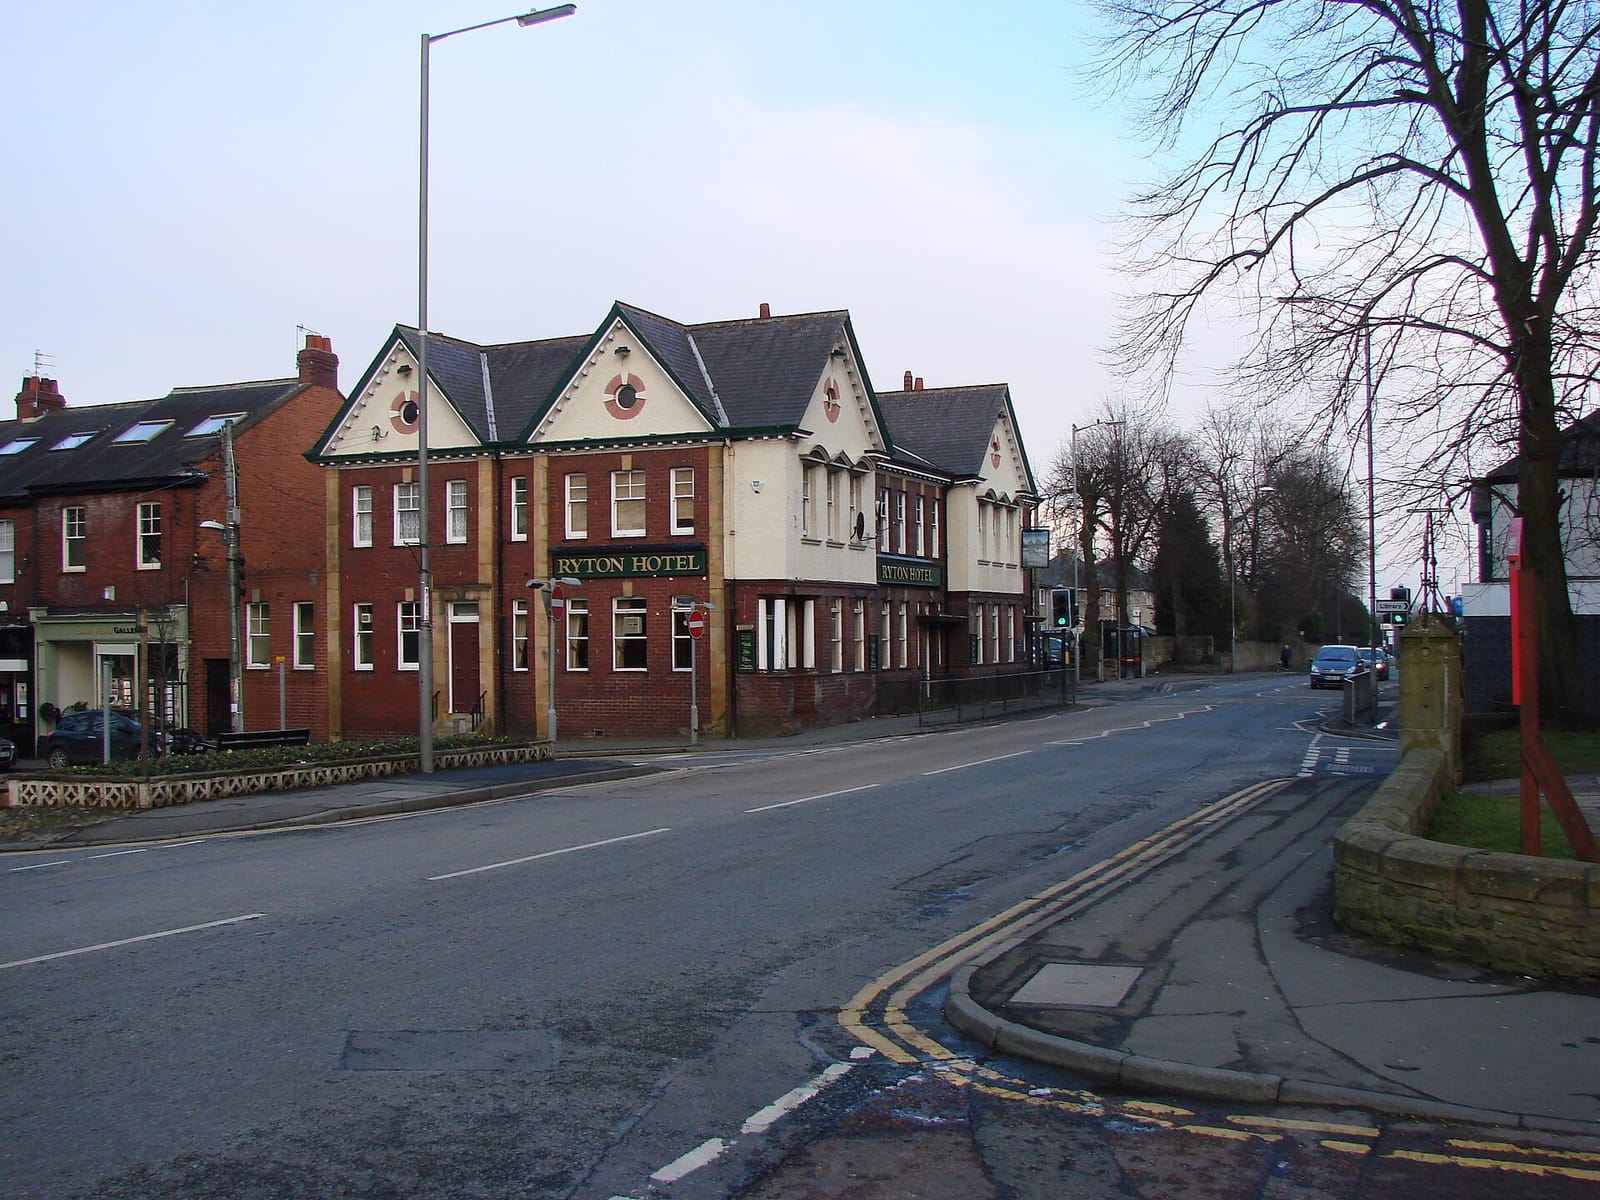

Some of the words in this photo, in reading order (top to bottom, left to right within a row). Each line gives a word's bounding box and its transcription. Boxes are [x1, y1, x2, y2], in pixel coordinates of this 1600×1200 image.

[557, 557, 625, 574] RYTON
[631, 555, 700, 572] HOTEL
[882, 565, 909, 580] RYTON
[909, 567, 933, 582] HOTEL
[1379, 602, 1402, 610] Library
[113, 626, 138, 634] GALLE
